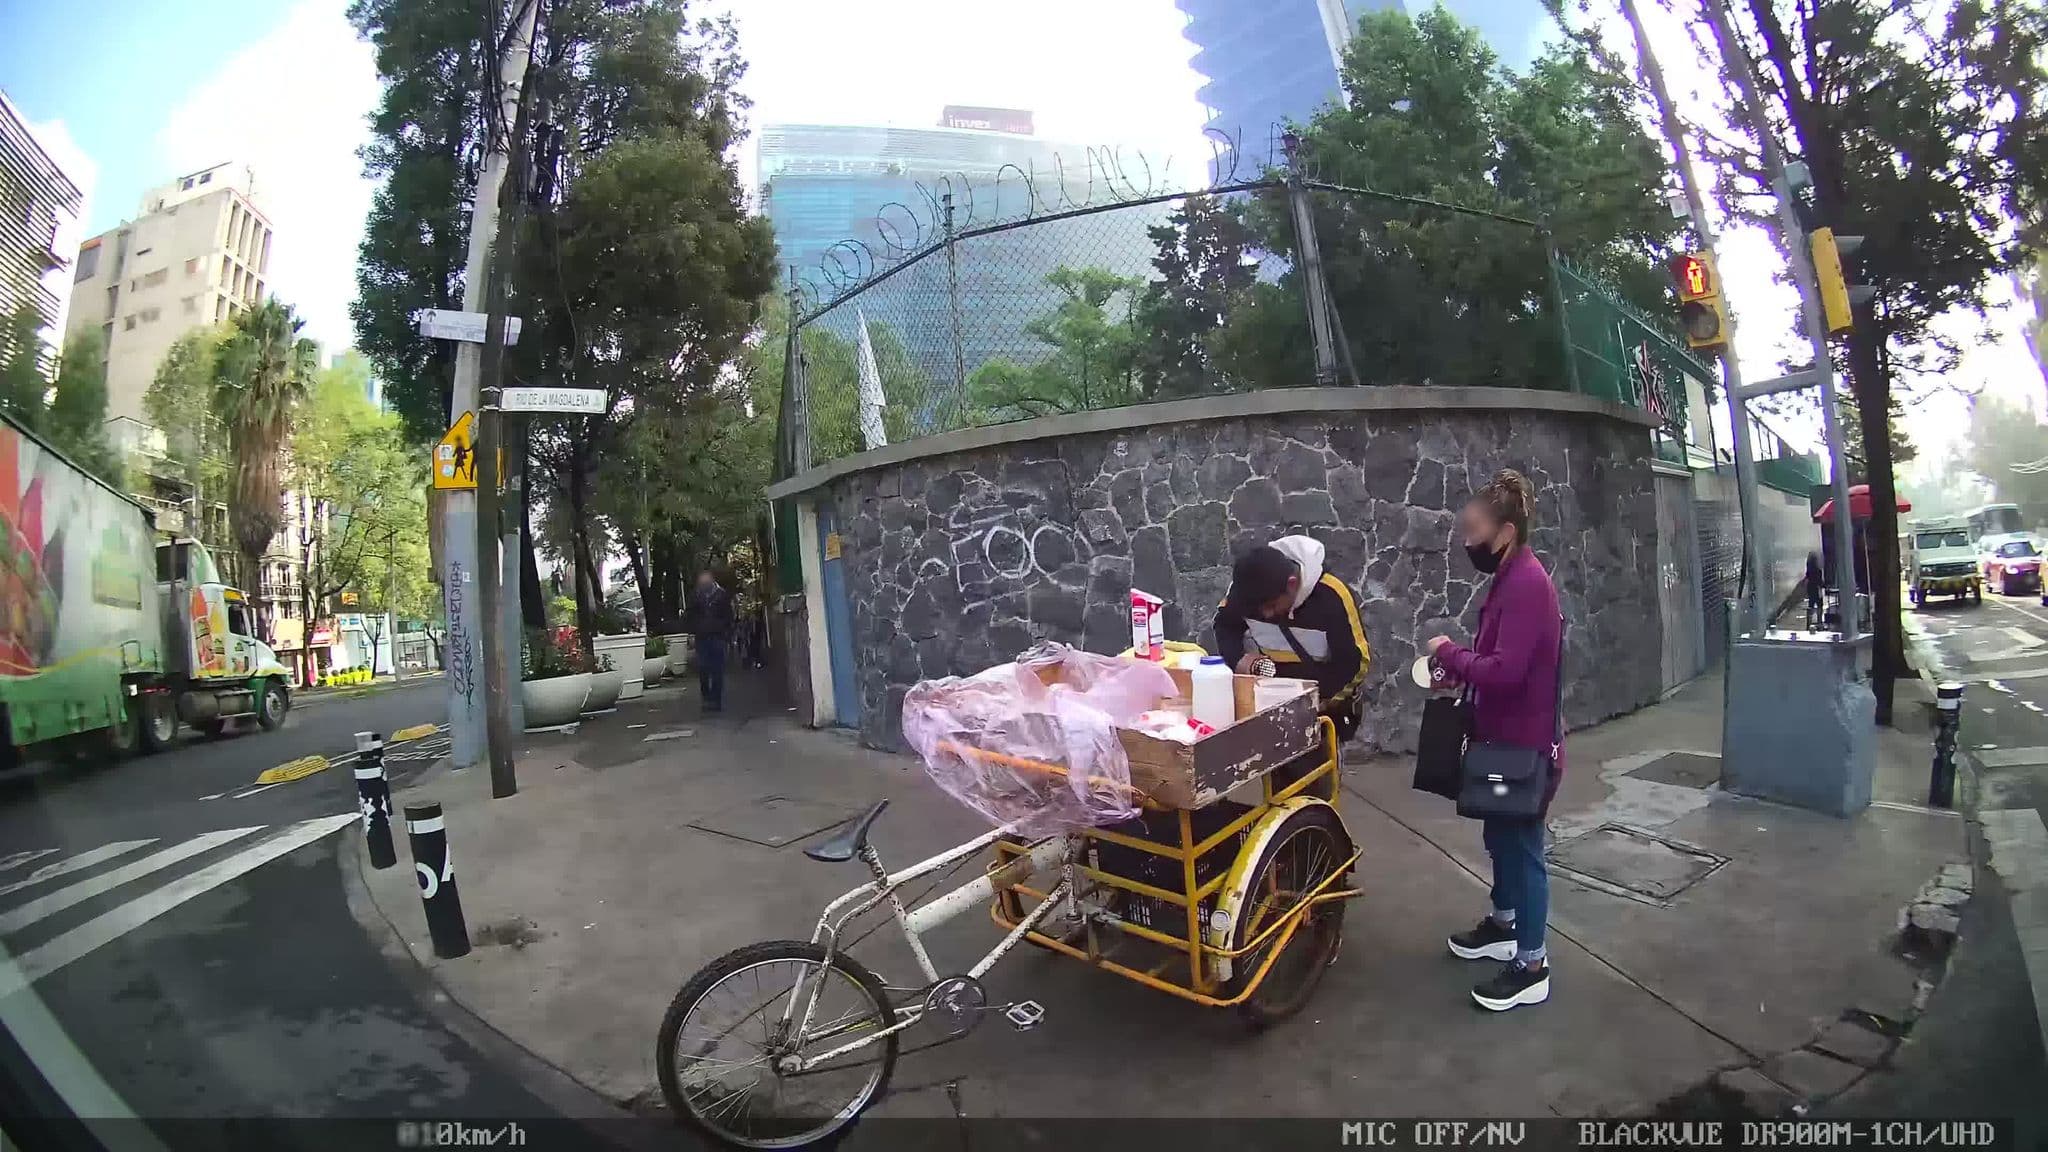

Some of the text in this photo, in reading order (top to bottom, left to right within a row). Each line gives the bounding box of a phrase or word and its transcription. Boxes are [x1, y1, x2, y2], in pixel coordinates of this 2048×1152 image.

[528, 393, 538, 406] DE
[539, 393, 547, 406] LA
[548, 393, 590, 407] MAGDALENA
